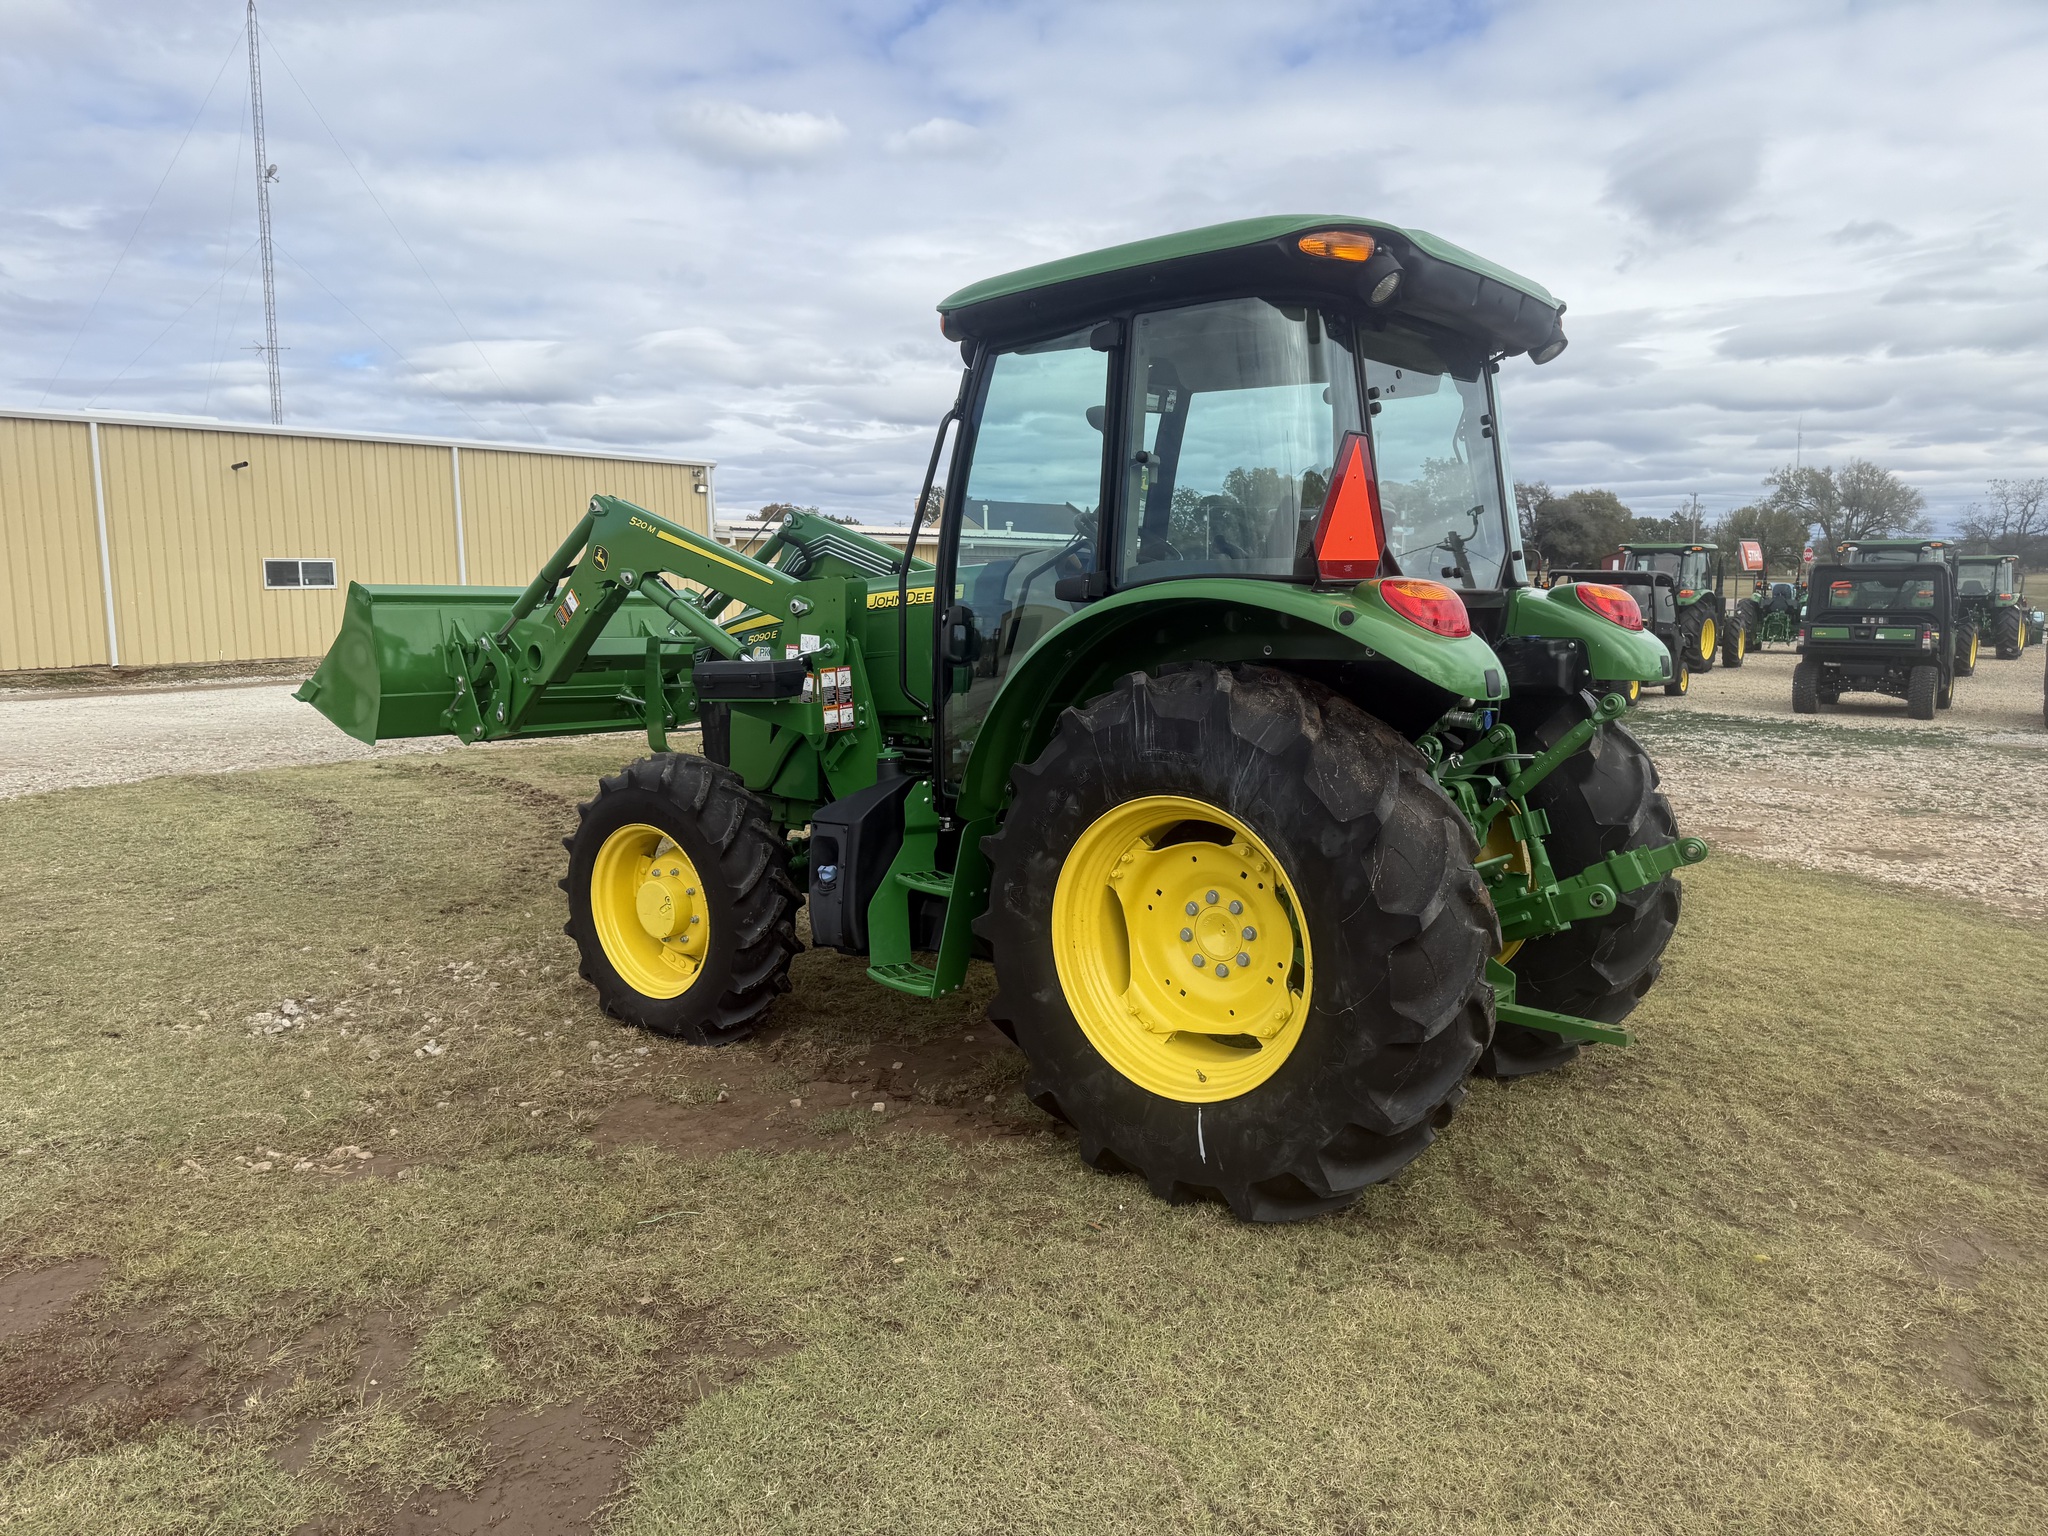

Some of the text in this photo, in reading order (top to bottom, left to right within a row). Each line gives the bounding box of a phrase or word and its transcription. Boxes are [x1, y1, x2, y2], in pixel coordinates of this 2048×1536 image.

[629, 516, 657, 534] 520 M
[906, 591, 933, 604] DEE
[747, 630, 778, 646] 5090 E
